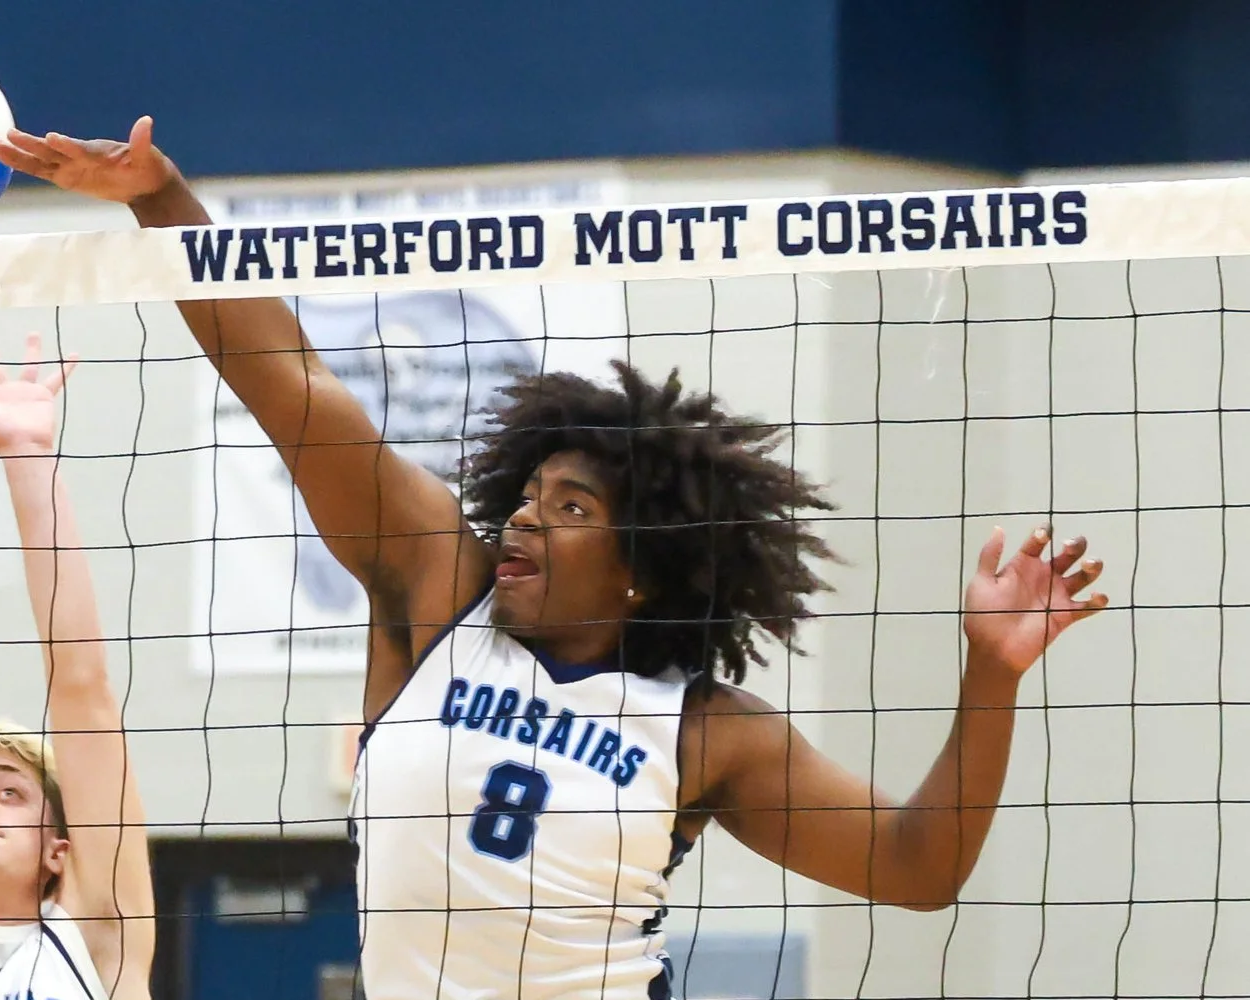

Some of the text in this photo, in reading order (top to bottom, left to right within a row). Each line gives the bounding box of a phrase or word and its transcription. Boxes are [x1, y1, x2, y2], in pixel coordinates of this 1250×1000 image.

[180, 190, 1087, 282] WATERFORD MOTT CORSAIRS
[440, 677, 648, 788] CORSAIRS
[467, 760, 553, 863] 8
